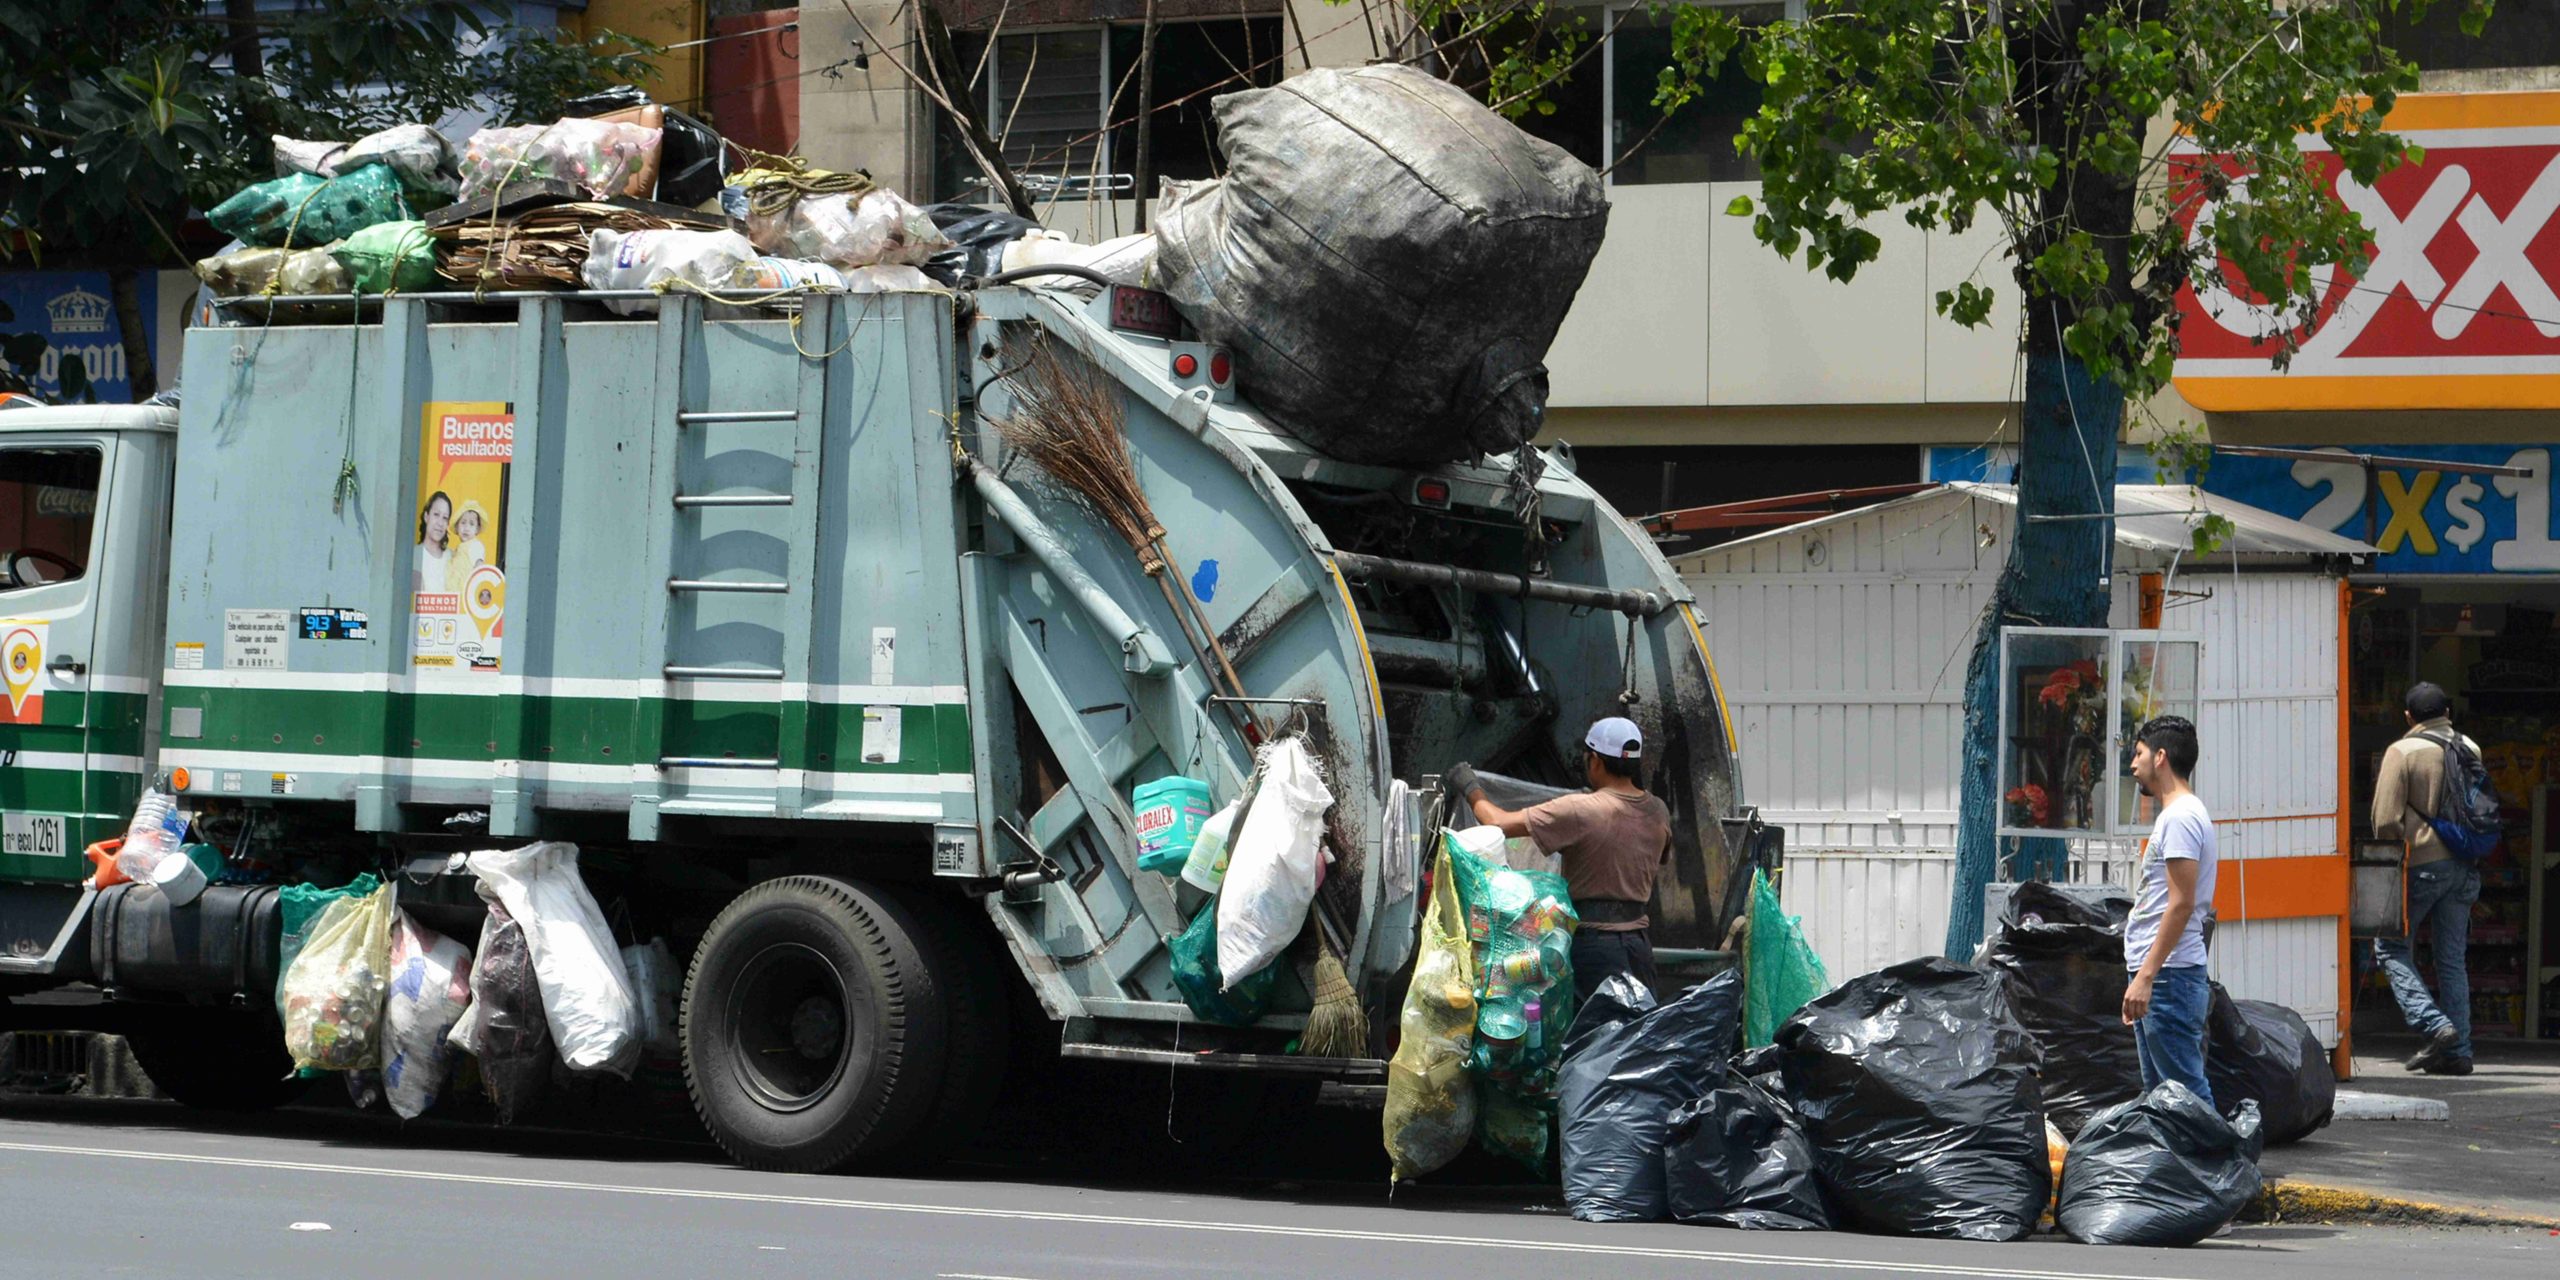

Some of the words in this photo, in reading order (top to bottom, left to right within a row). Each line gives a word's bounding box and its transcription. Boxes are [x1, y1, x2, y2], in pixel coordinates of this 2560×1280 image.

[442, 416, 514, 441] Buenos
[441, 440, 513, 457] resultados
[416, 596, 457, 605] BUENOS
[1136, 807, 1173, 834] CLORALEX
